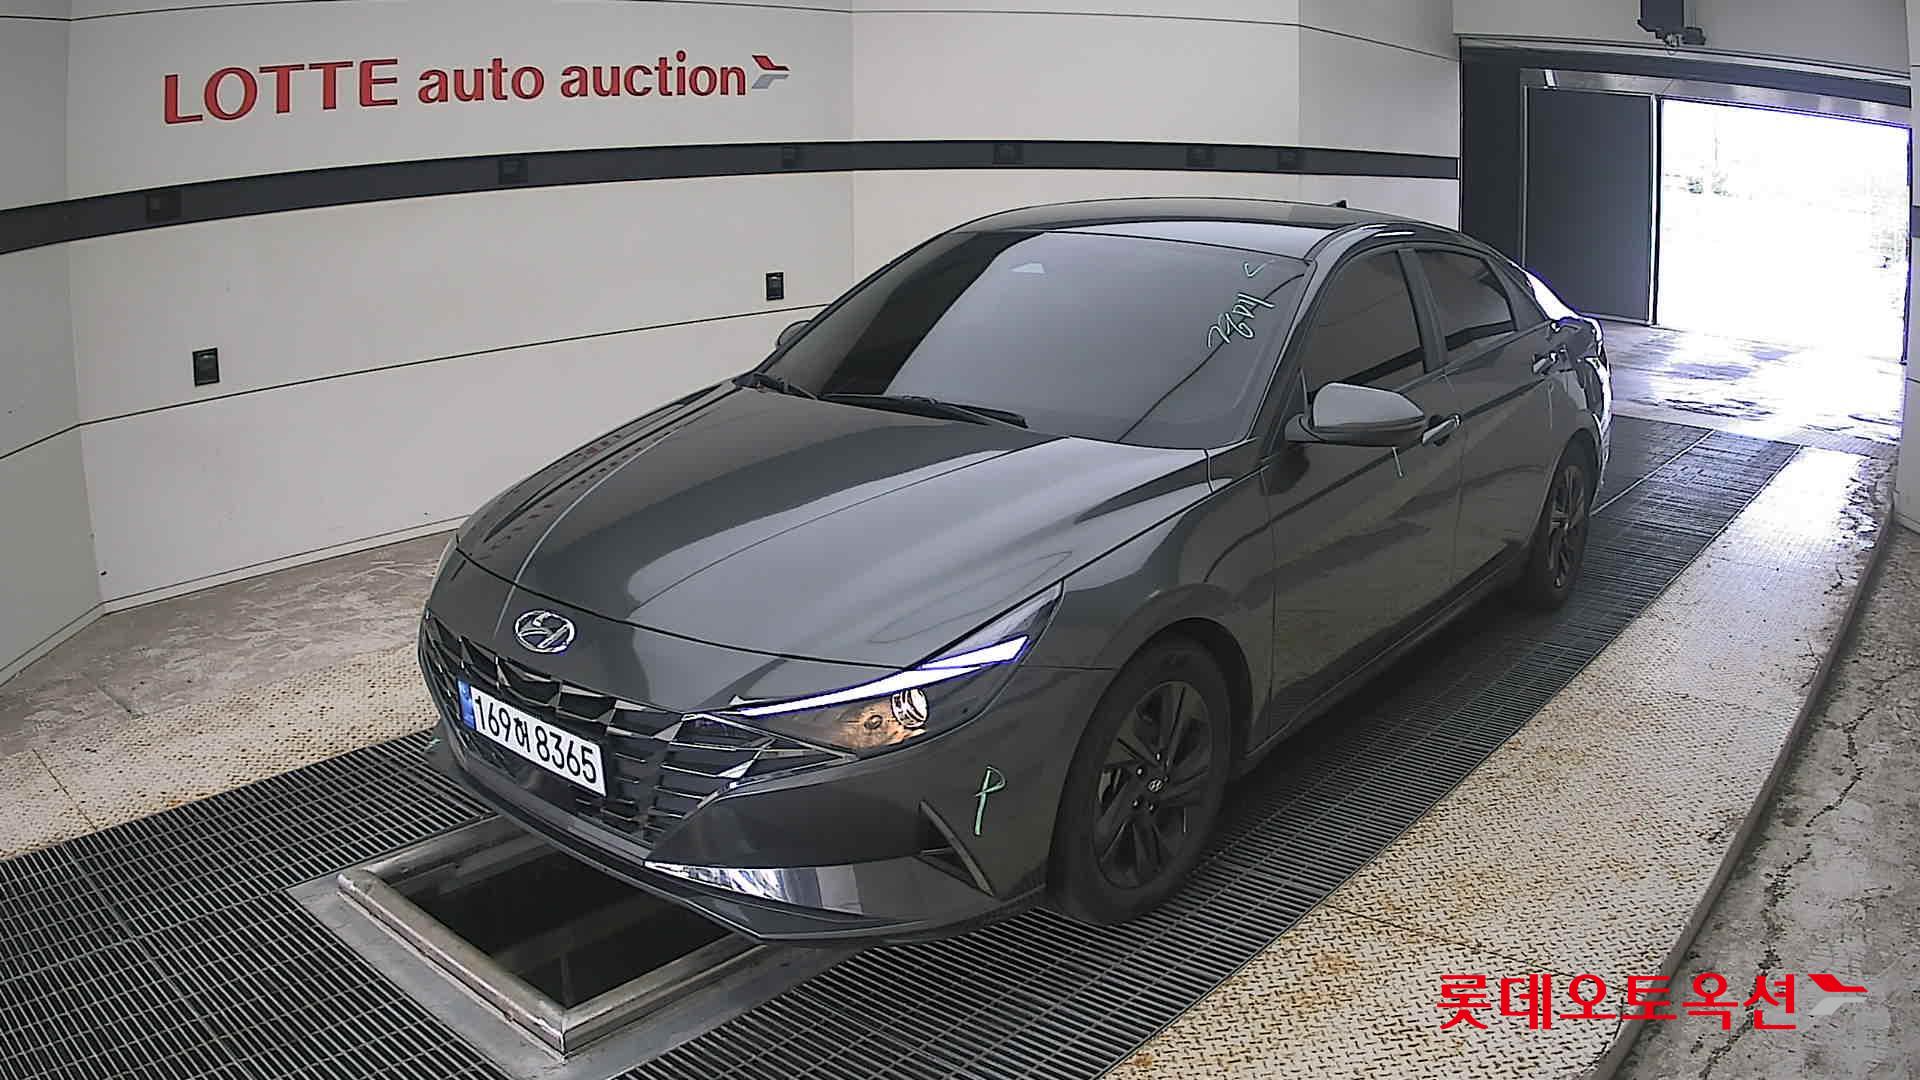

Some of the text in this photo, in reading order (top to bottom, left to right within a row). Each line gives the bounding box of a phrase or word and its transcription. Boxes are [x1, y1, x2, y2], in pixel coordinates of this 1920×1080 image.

[163, 49, 747, 125] LOTTE auto auction
[474, 695, 597, 784] 169허 8365
